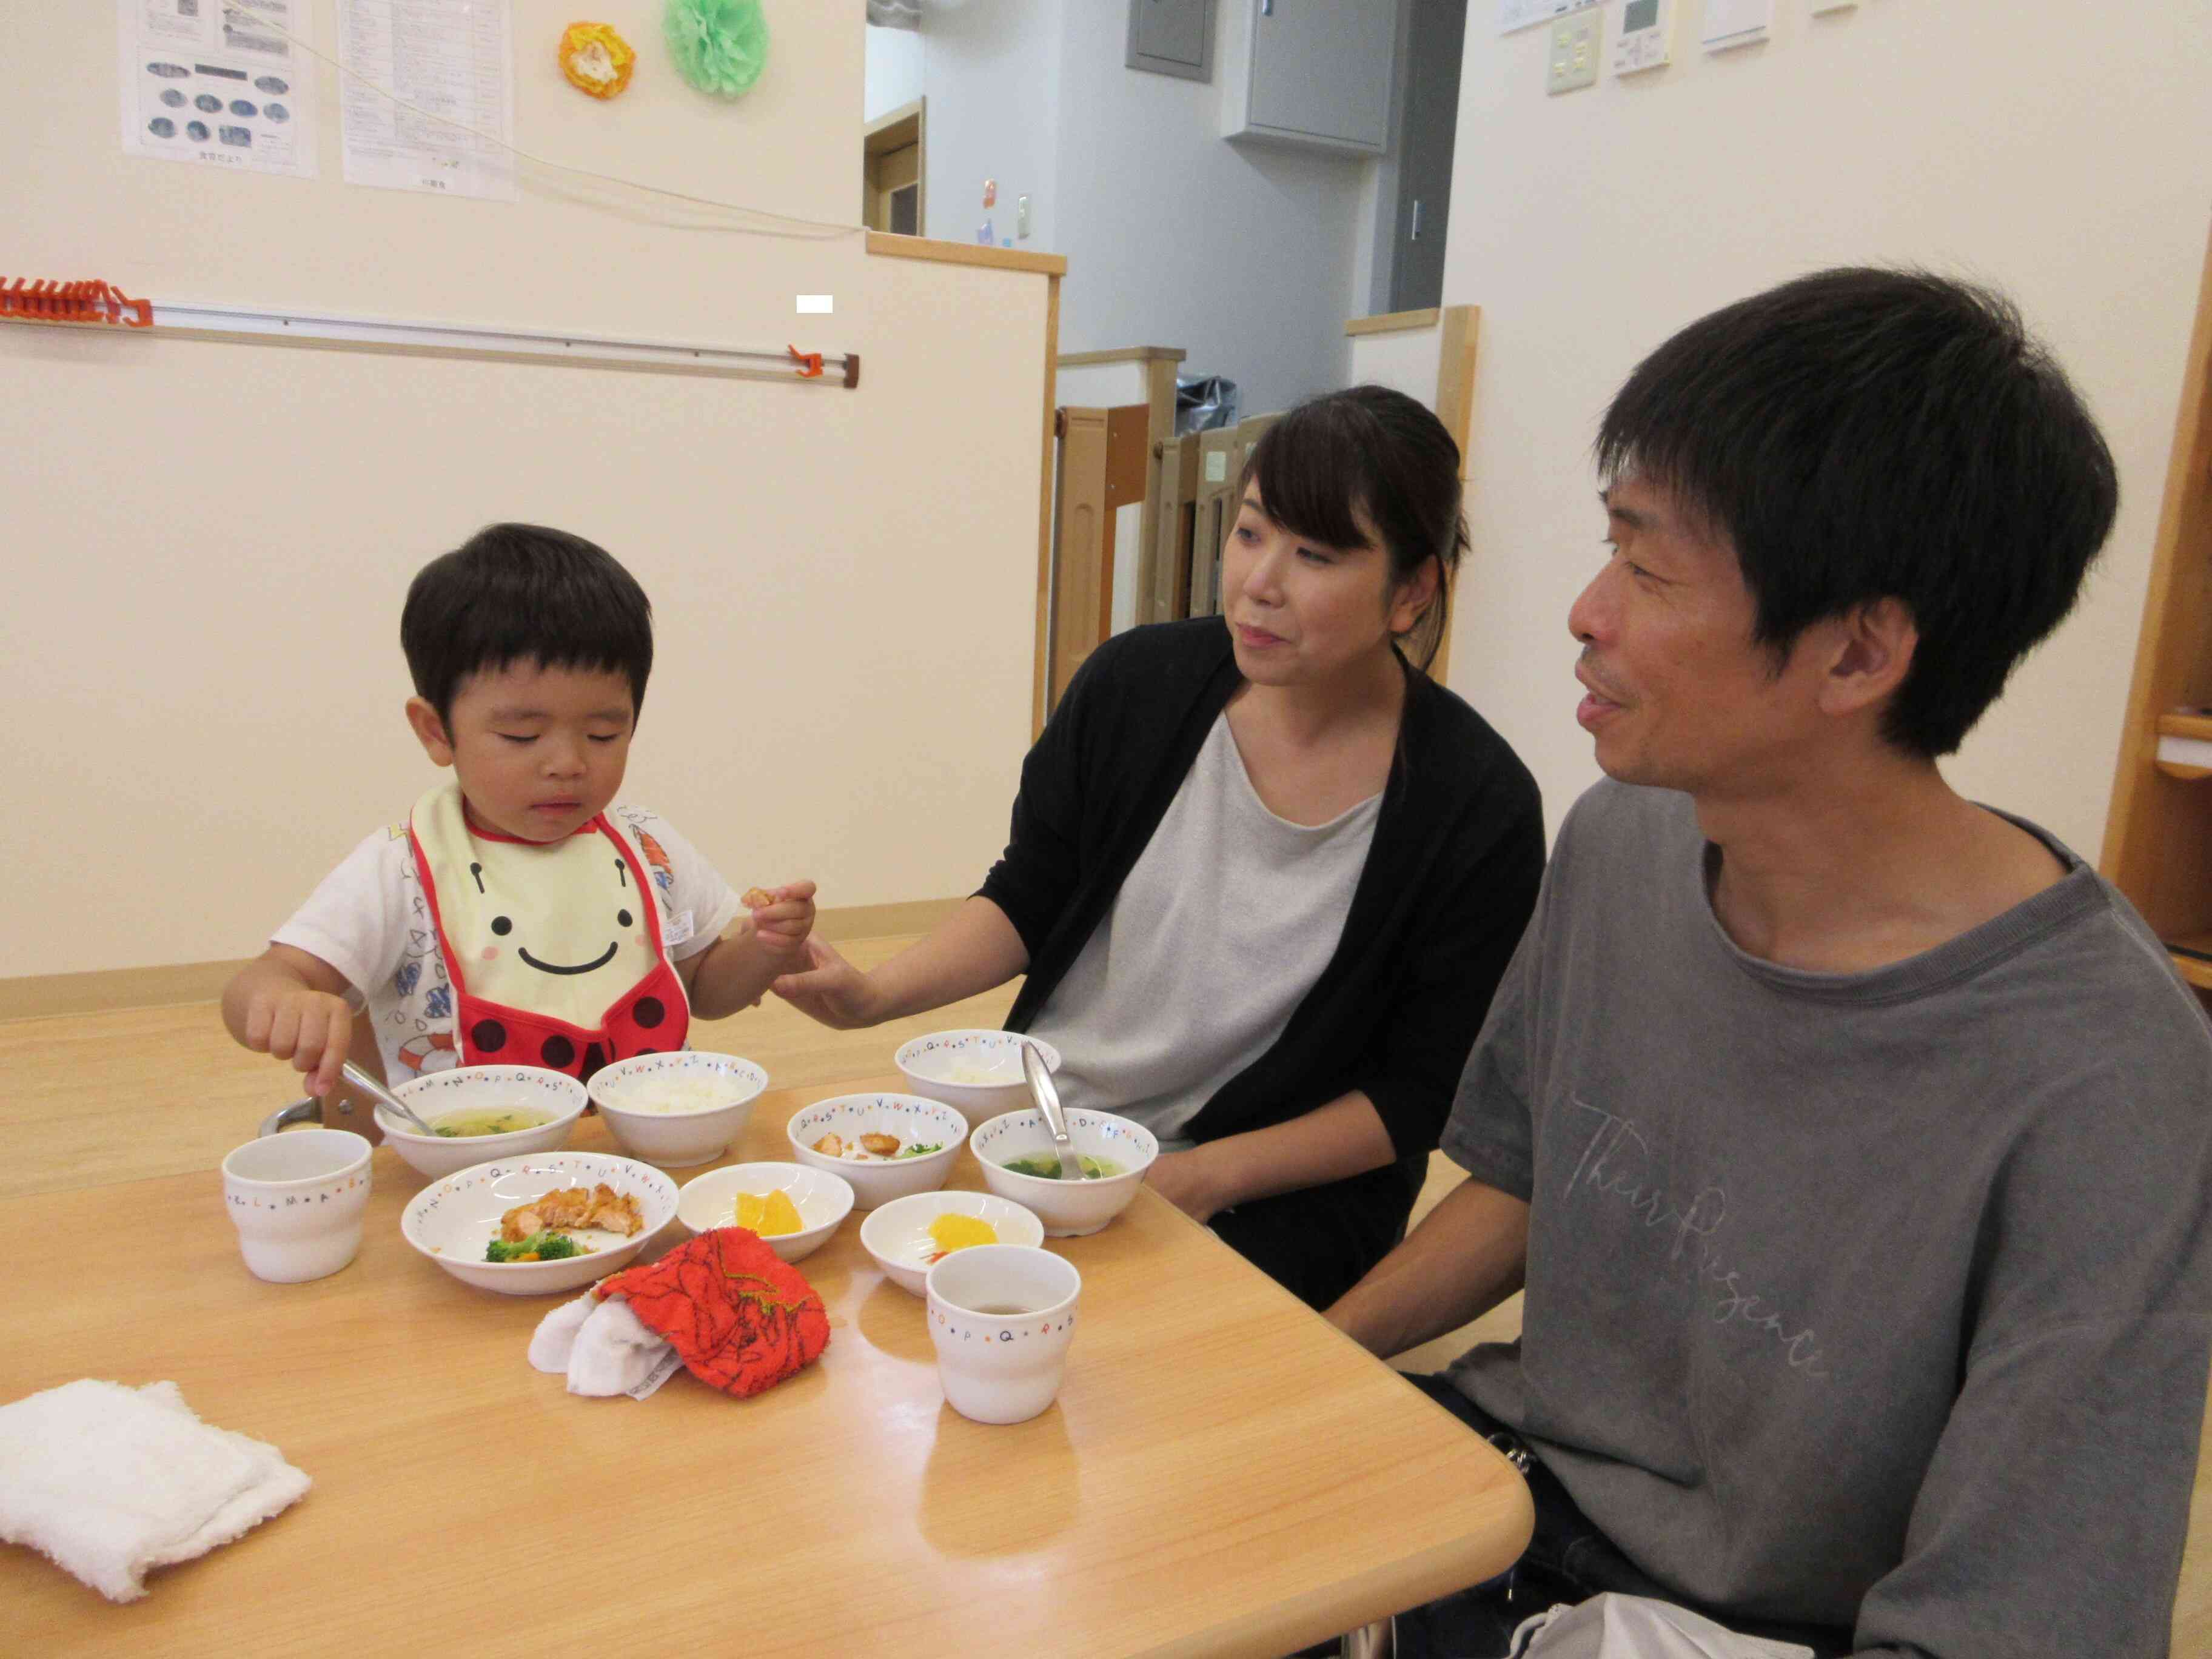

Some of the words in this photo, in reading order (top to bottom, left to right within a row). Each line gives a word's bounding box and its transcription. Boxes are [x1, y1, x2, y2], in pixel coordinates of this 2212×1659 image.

[927, 1042, 934, 1050] Q
[655, 1060, 664, 1069] X
[452, 1077, 464, 1087] N
[475, 1071, 484, 1080] O
[516, 1073, 526, 1082] Q
[552, 1082, 558, 1090] S
[825, 1113, 833, 1121] S
[876, 1099, 883, 1107] V
[893, 1102, 903, 1111] W
[914, 1105, 921, 1113] X
[1029, 1119, 1036, 1128] A
[1113, 1130, 1119, 1139] F
[429, 1199, 439, 1208] N
[443, 1184, 452, 1193] O
[491, 1168, 502, 1178] Q
[573, 1160, 580, 1168] T
[597, 1168, 606, 1178] U
[625, 1164, 632, 1173] V
[655, 1184, 663, 1193] X
[254, 1197, 261, 1207] L
[286, 1196, 297, 1206] M
[321, 1193, 329, 1202] A
[939, 1313, 945, 1324] O
[1000, 1330, 1014, 1341] Q
[1067, 1315, 1073, 1326] S
